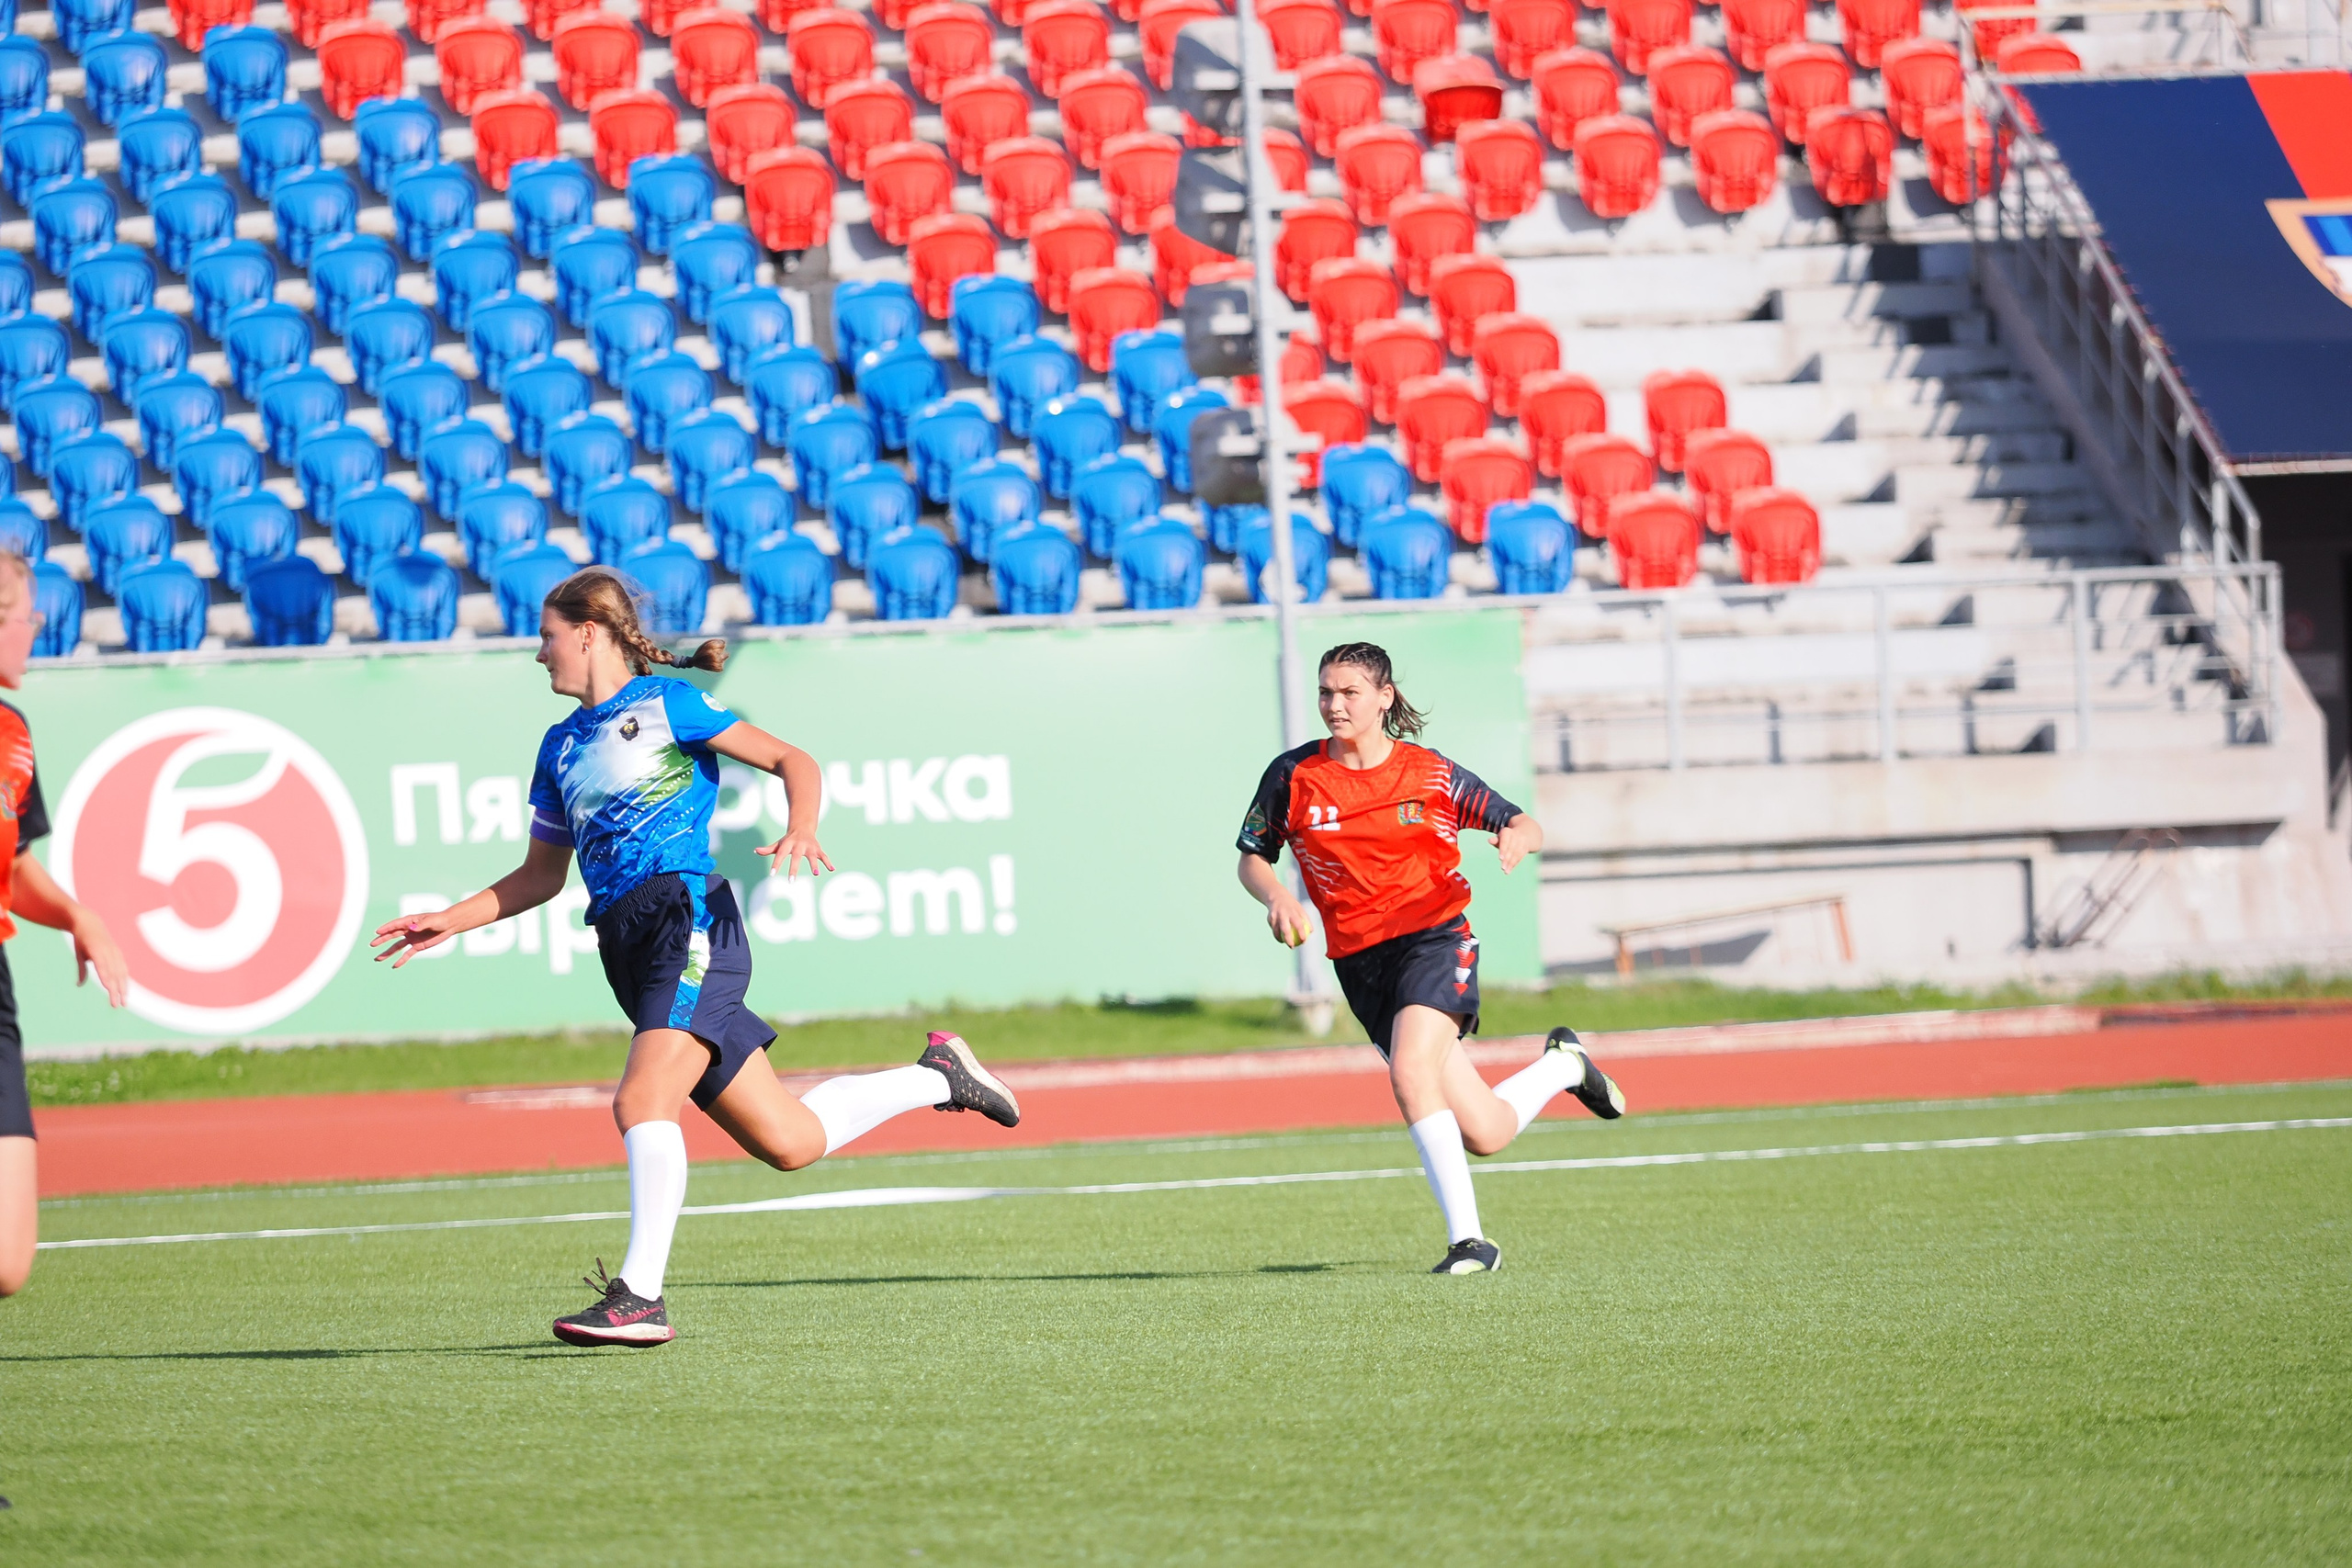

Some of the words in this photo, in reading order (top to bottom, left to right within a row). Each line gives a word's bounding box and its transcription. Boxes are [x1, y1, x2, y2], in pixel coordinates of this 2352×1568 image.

[390, 753, 1013, 855] Пярчка
[557, 735, 574, 775] 2
[399, 853, 1018, 976] вырает!
